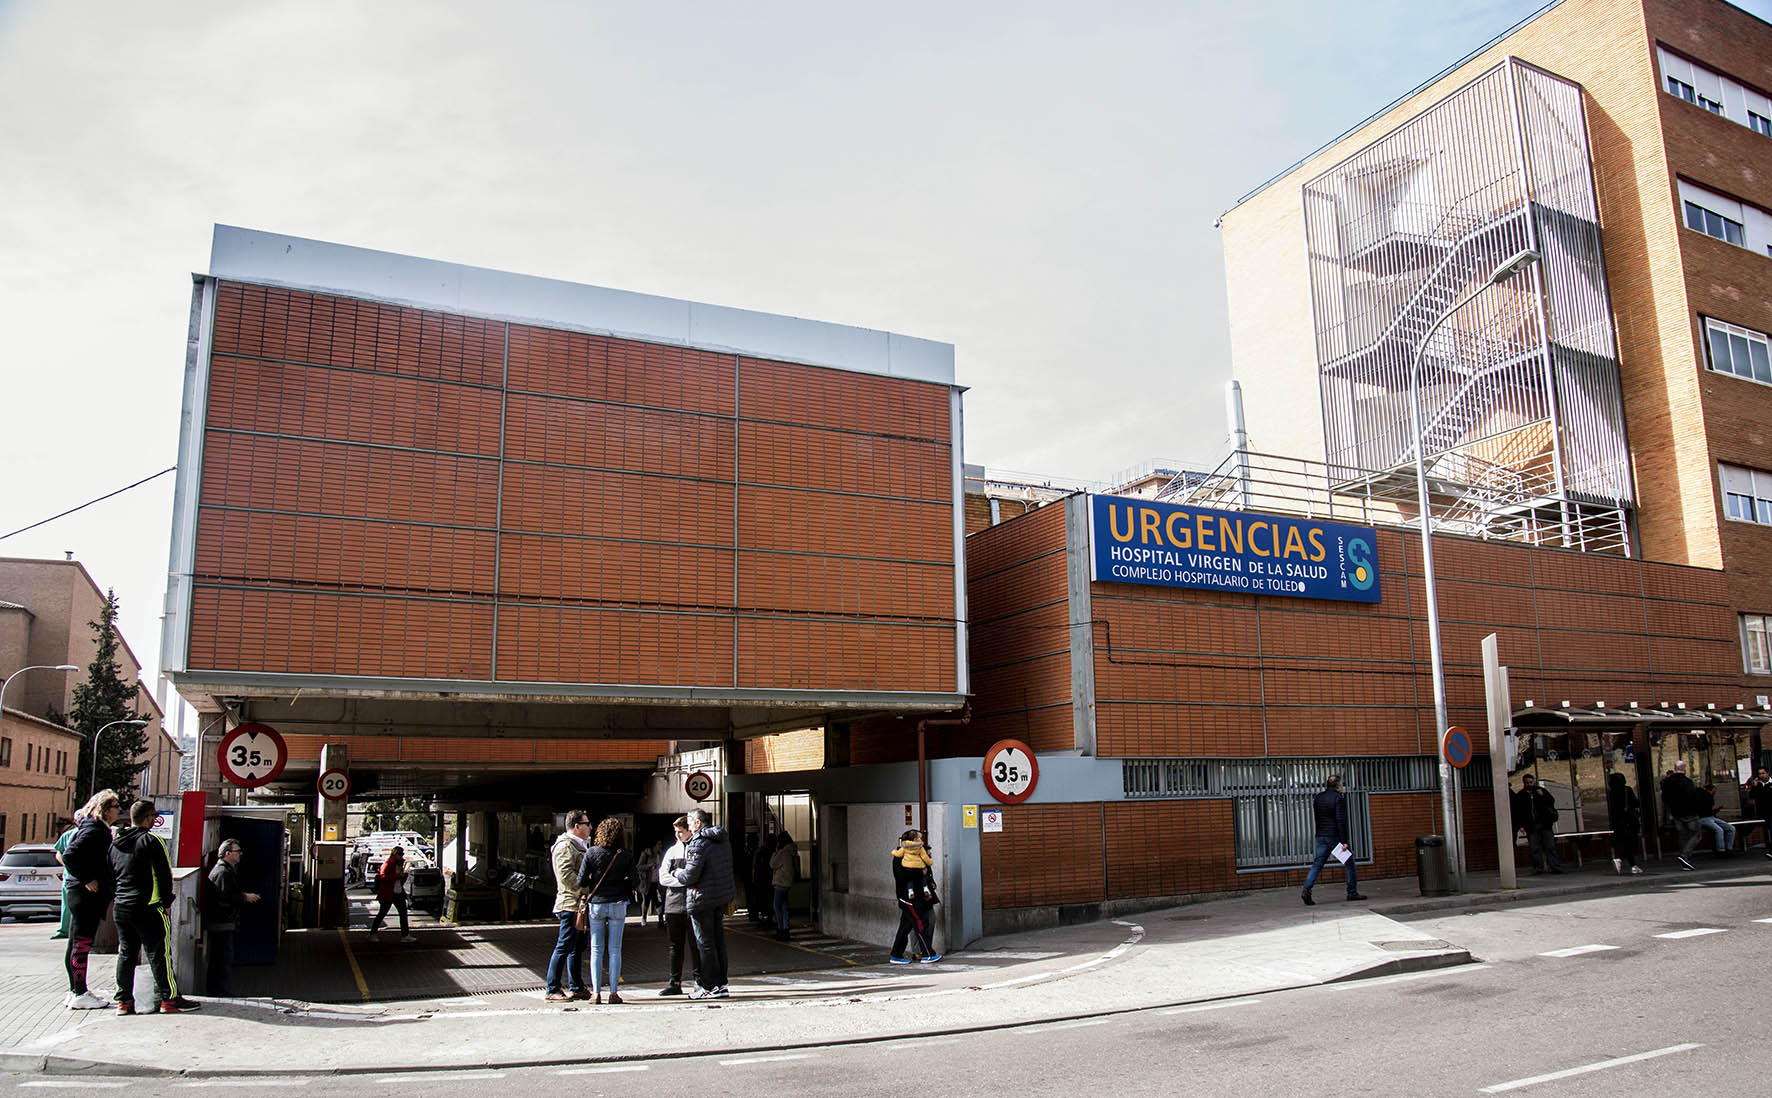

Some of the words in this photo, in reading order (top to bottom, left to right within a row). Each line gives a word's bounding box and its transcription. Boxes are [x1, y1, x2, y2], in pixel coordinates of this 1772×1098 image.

[1109, 504, 1326, 562] URGENCIAS
[1111, 546, 1183, 567] HOSPITAL
[1188, 553, 1242, 572] VIRGEN
[1249, 561, 1264, 574] DE
[1268, 563, 1283, 576] LA
[1286, 563, 1328, 579] SALUD
[1337, 536, 1347, 588] SESCAM
[1112, 565, 1171, 581] COMPLEJO
[1174, 570, 1249, 589] HOSPITALARIO
[1252, 579, 1264, 590] DE
[1267, 579, 1306, 592] TOLEDO
[326, 779, 345, 790] 20
[691, 781, 707, 791] 20
